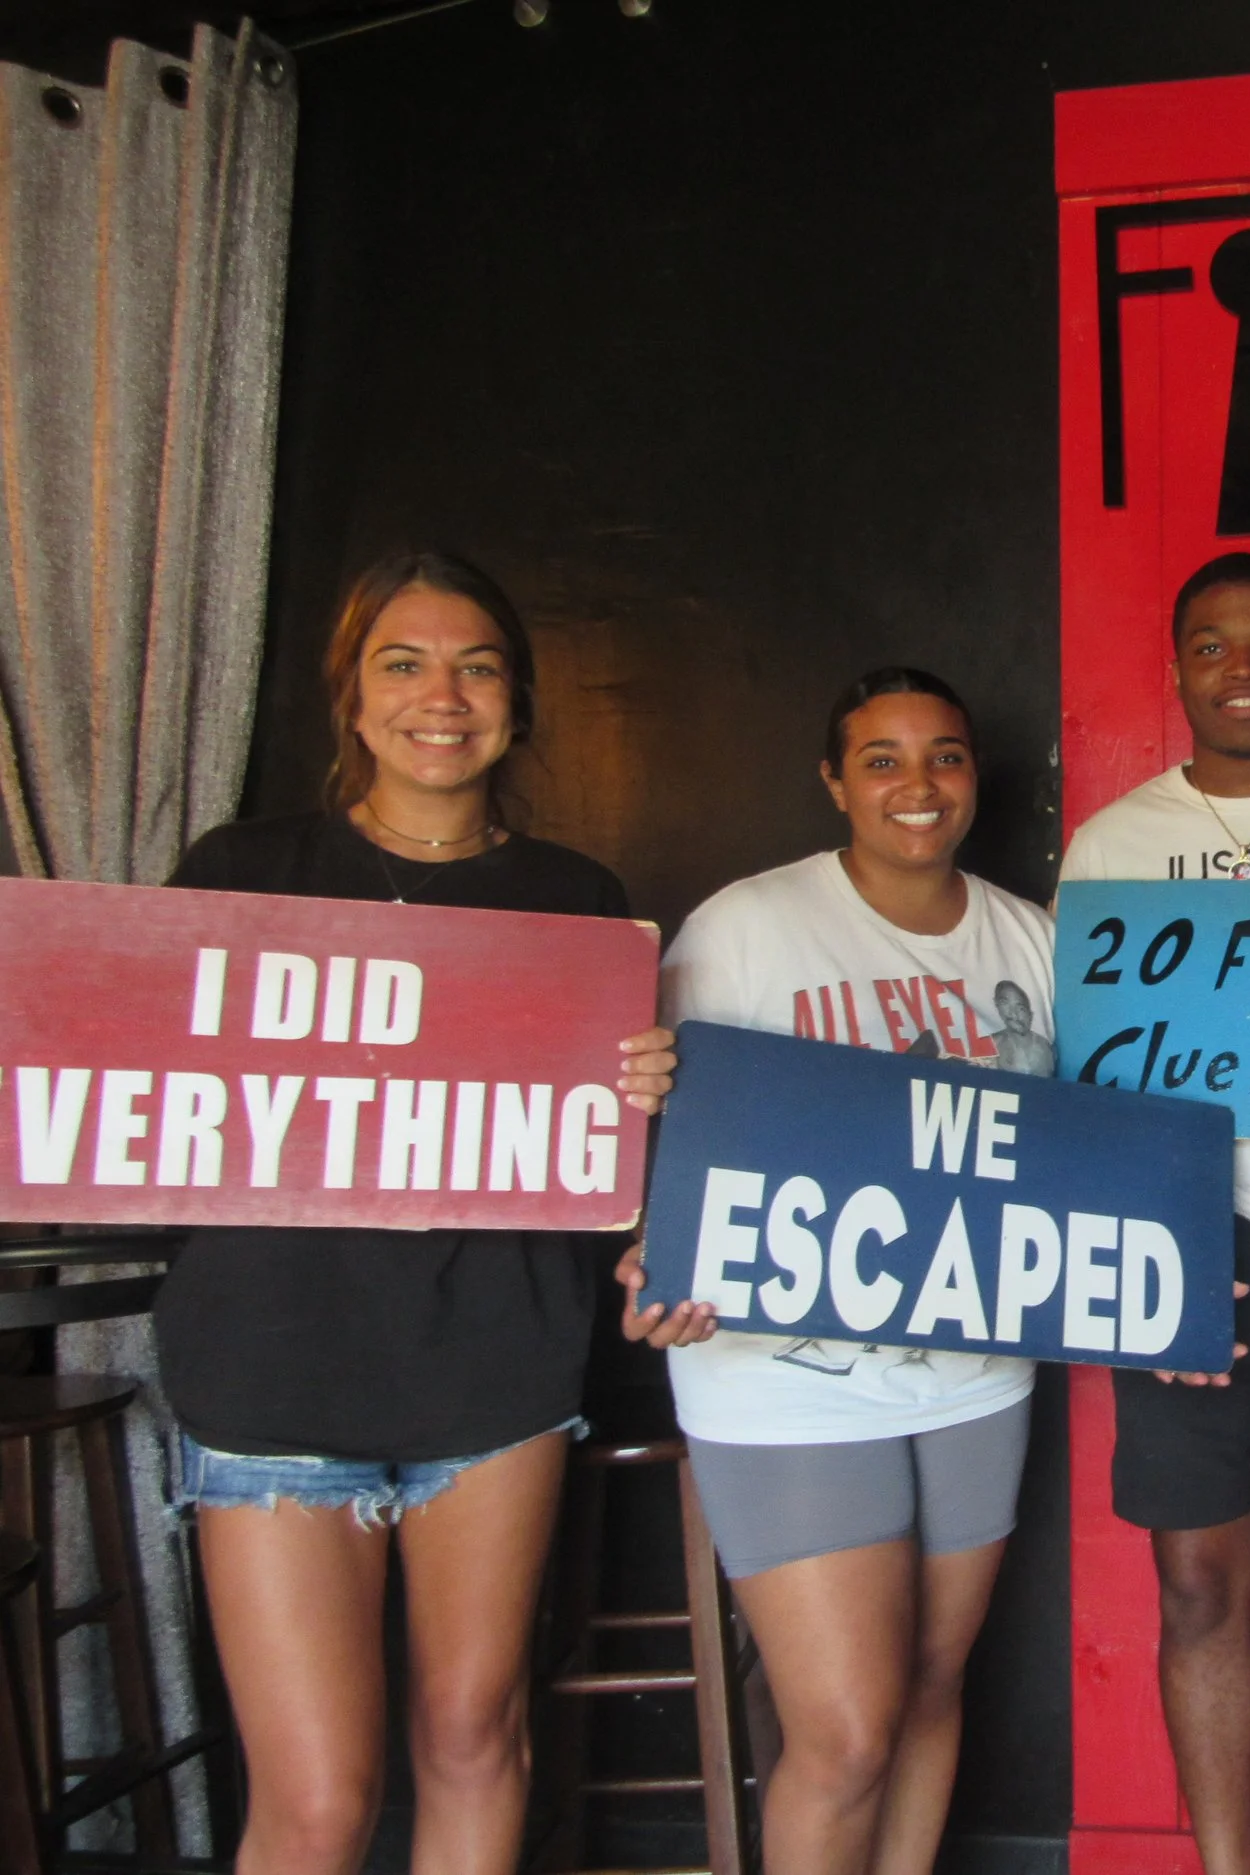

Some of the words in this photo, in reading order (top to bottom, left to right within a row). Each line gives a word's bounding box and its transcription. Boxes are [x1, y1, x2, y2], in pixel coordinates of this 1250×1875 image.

[190, 947, 228, 1036] I
[251, 952, 423, 1045] DID
[1082, 917, 1194, 985] 20
[0, 1066, 620, 1194] VERYTHING
[910, 1078, 1020, 1181] WE
[691, 1167, 1184, 1355] ESCAPED
